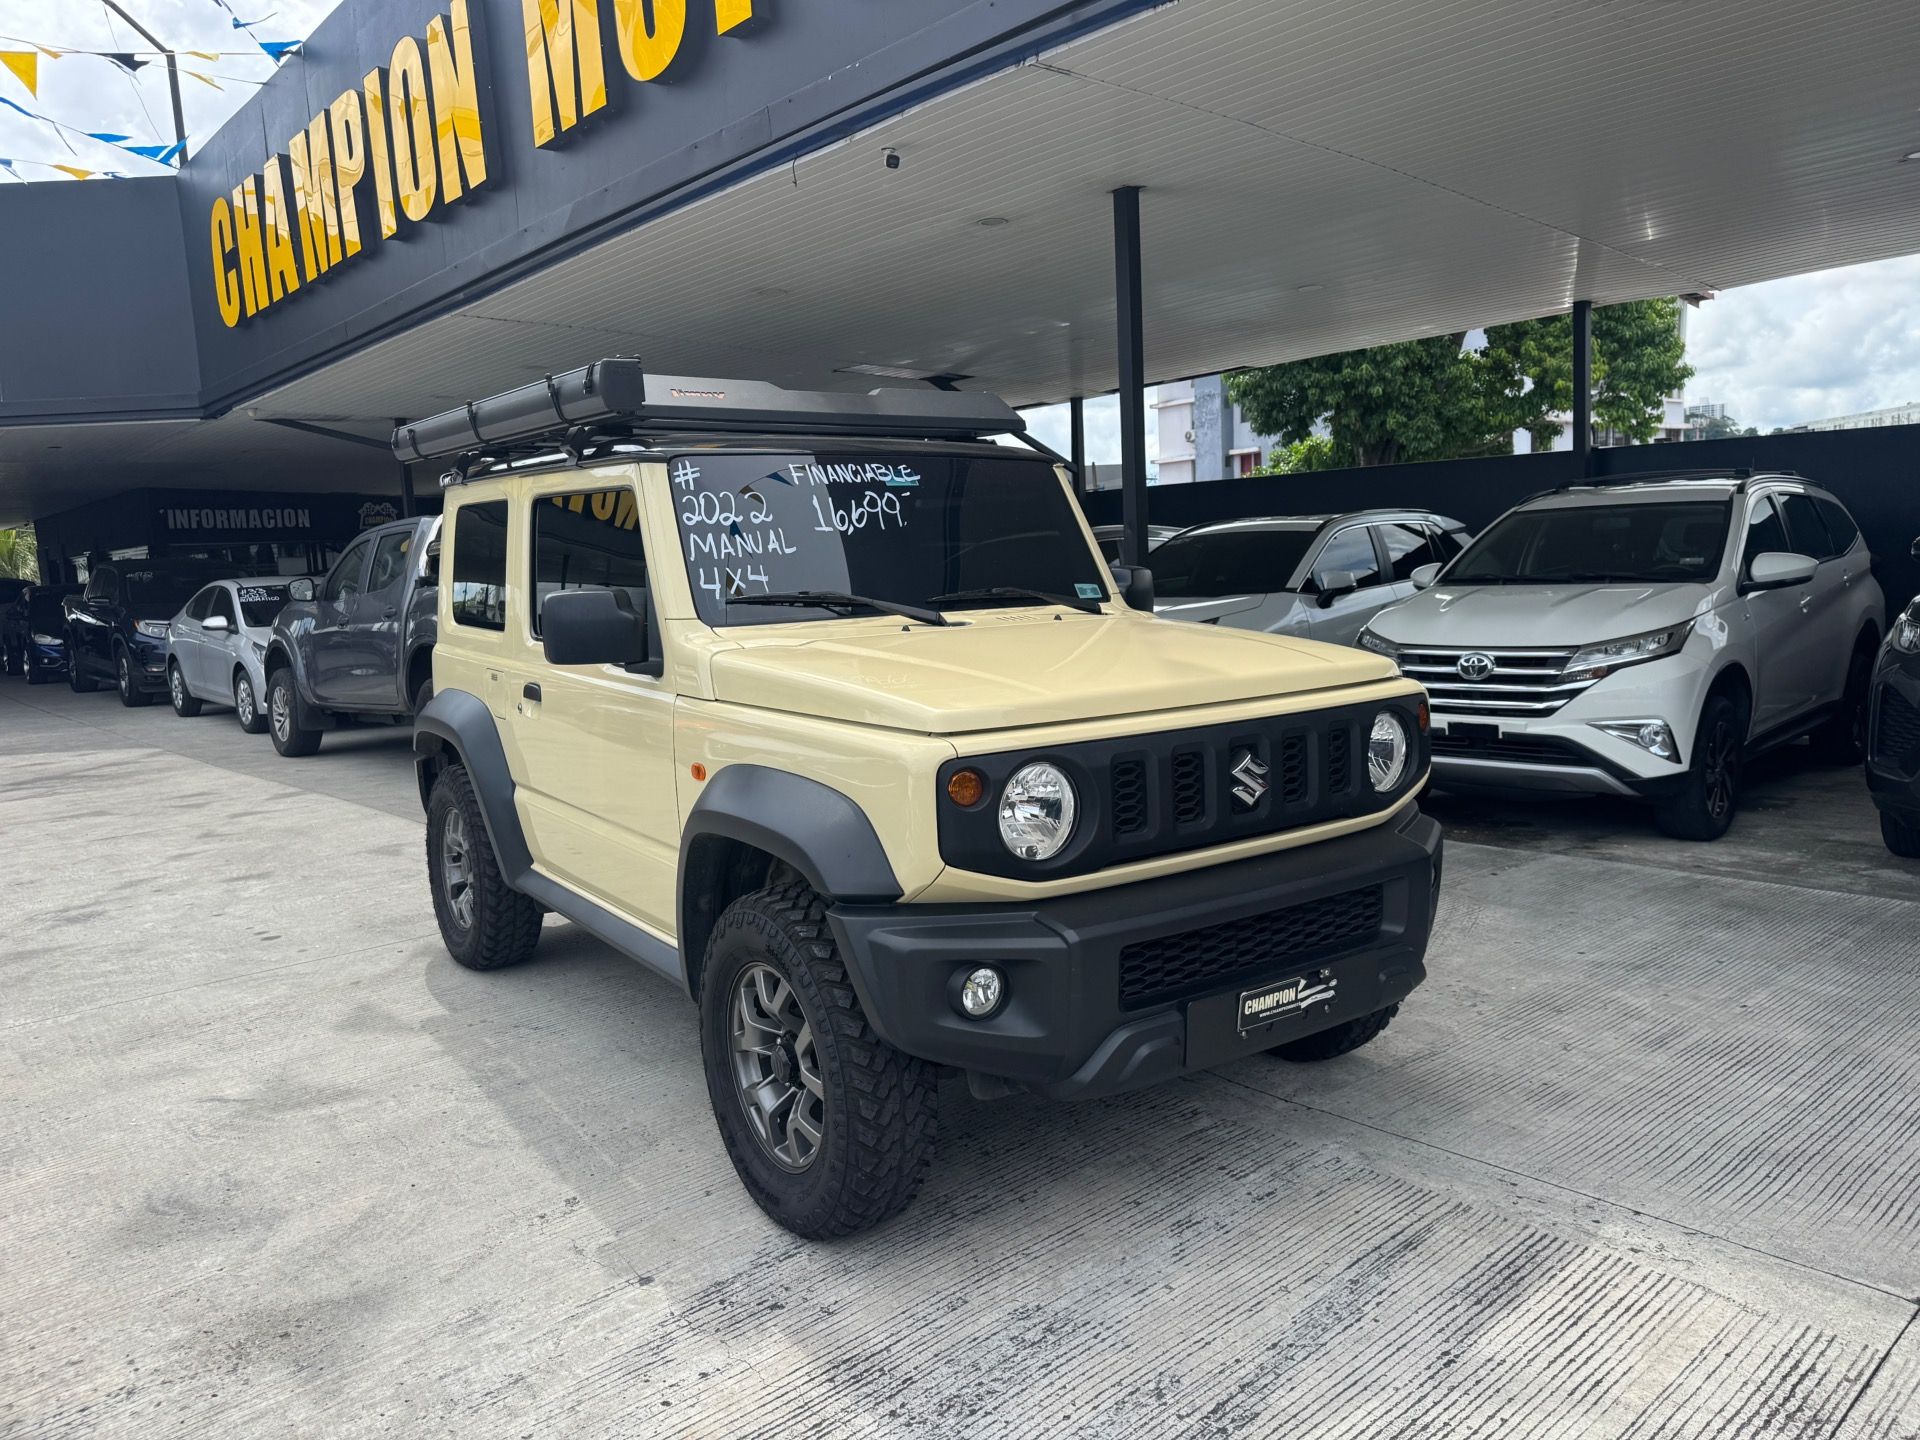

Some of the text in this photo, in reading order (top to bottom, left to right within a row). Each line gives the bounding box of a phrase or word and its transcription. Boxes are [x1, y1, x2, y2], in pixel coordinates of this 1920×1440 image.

[211, 0, 487, 328] CHAMPION
[788, 463, 921, 486] FINANCIABLE
[167, 508, 311, 529] INFORMACION
[682, 491, 773, 526] 2022
[689, 527, 797, 561] MANUAL
[1244, 987, 1296, 1015] CHAMPION
